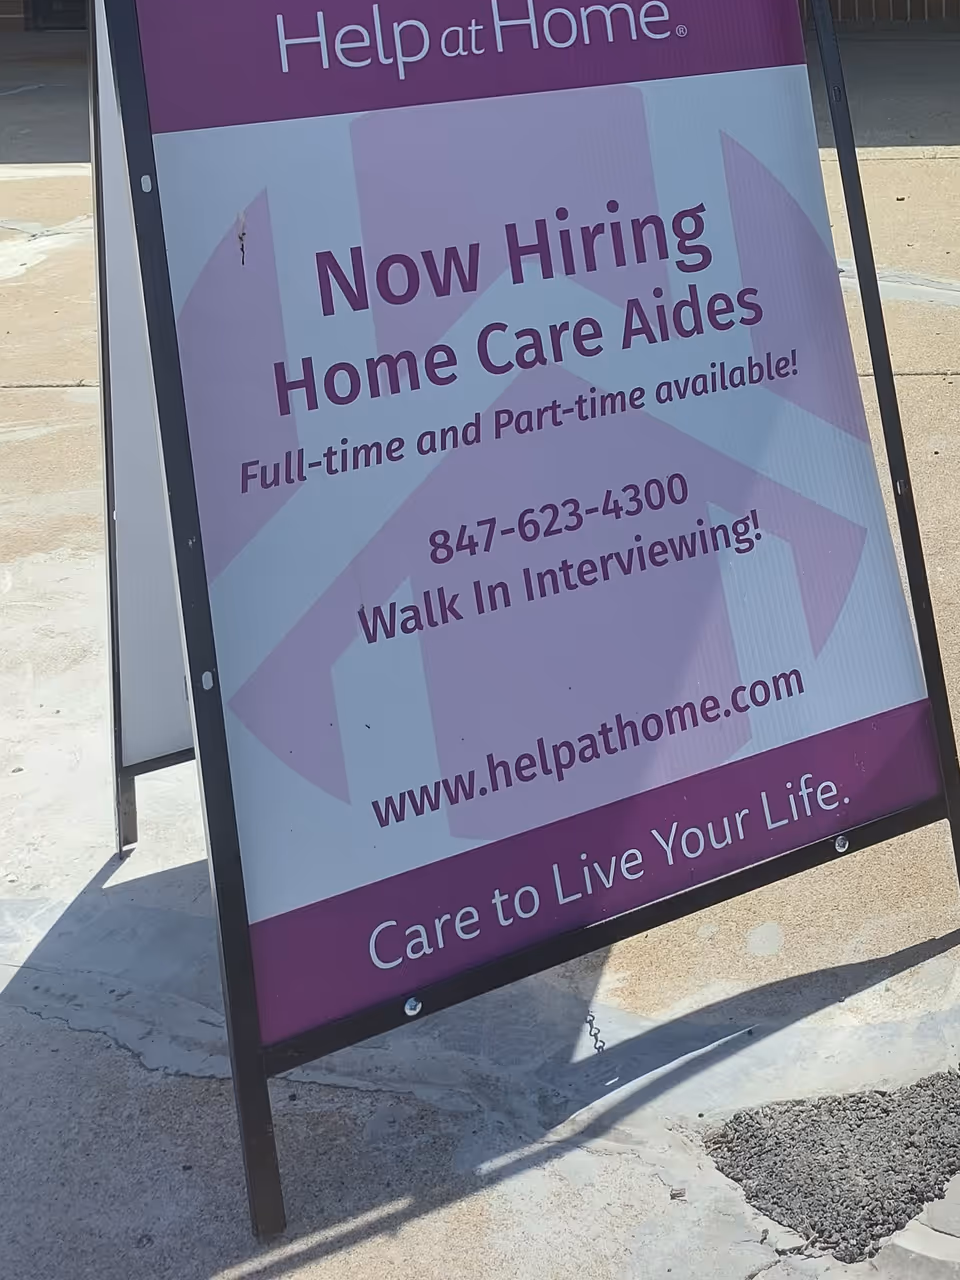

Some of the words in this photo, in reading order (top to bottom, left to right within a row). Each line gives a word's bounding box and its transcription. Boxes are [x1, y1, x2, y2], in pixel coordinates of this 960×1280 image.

[277, 4, 430, 80] Help
[440, 19, 484, 57] at
[315, 242, 480, 317] Now
[505, 200, 713, 285] Hiring
[273, 342, 458, 417] Home
[476, 314, 603, 375] Care
[621, 284, 764, 350] Aides
[240, 436, 405, 494] Full-time
[416, 413, 481, 456] and
[494, 385, 646, 440] Part-time
[656, 349, 798, 404] available!
[358, 586, 464, 644] Walk
[473, 579, 512, 615] In
[523, 509, 762, 601] Interviewing!
[428, 472, 688, 565] 847-623-4300
[371, 668, 804, 828] www.helpathome.com
[369, 905, 480, 970] Care
[492, 884, 540, 926] to
[552, 848, 645, 906] Live
[651, 808, 749, 866] Your
[761, 774, 850, 830] Life.
